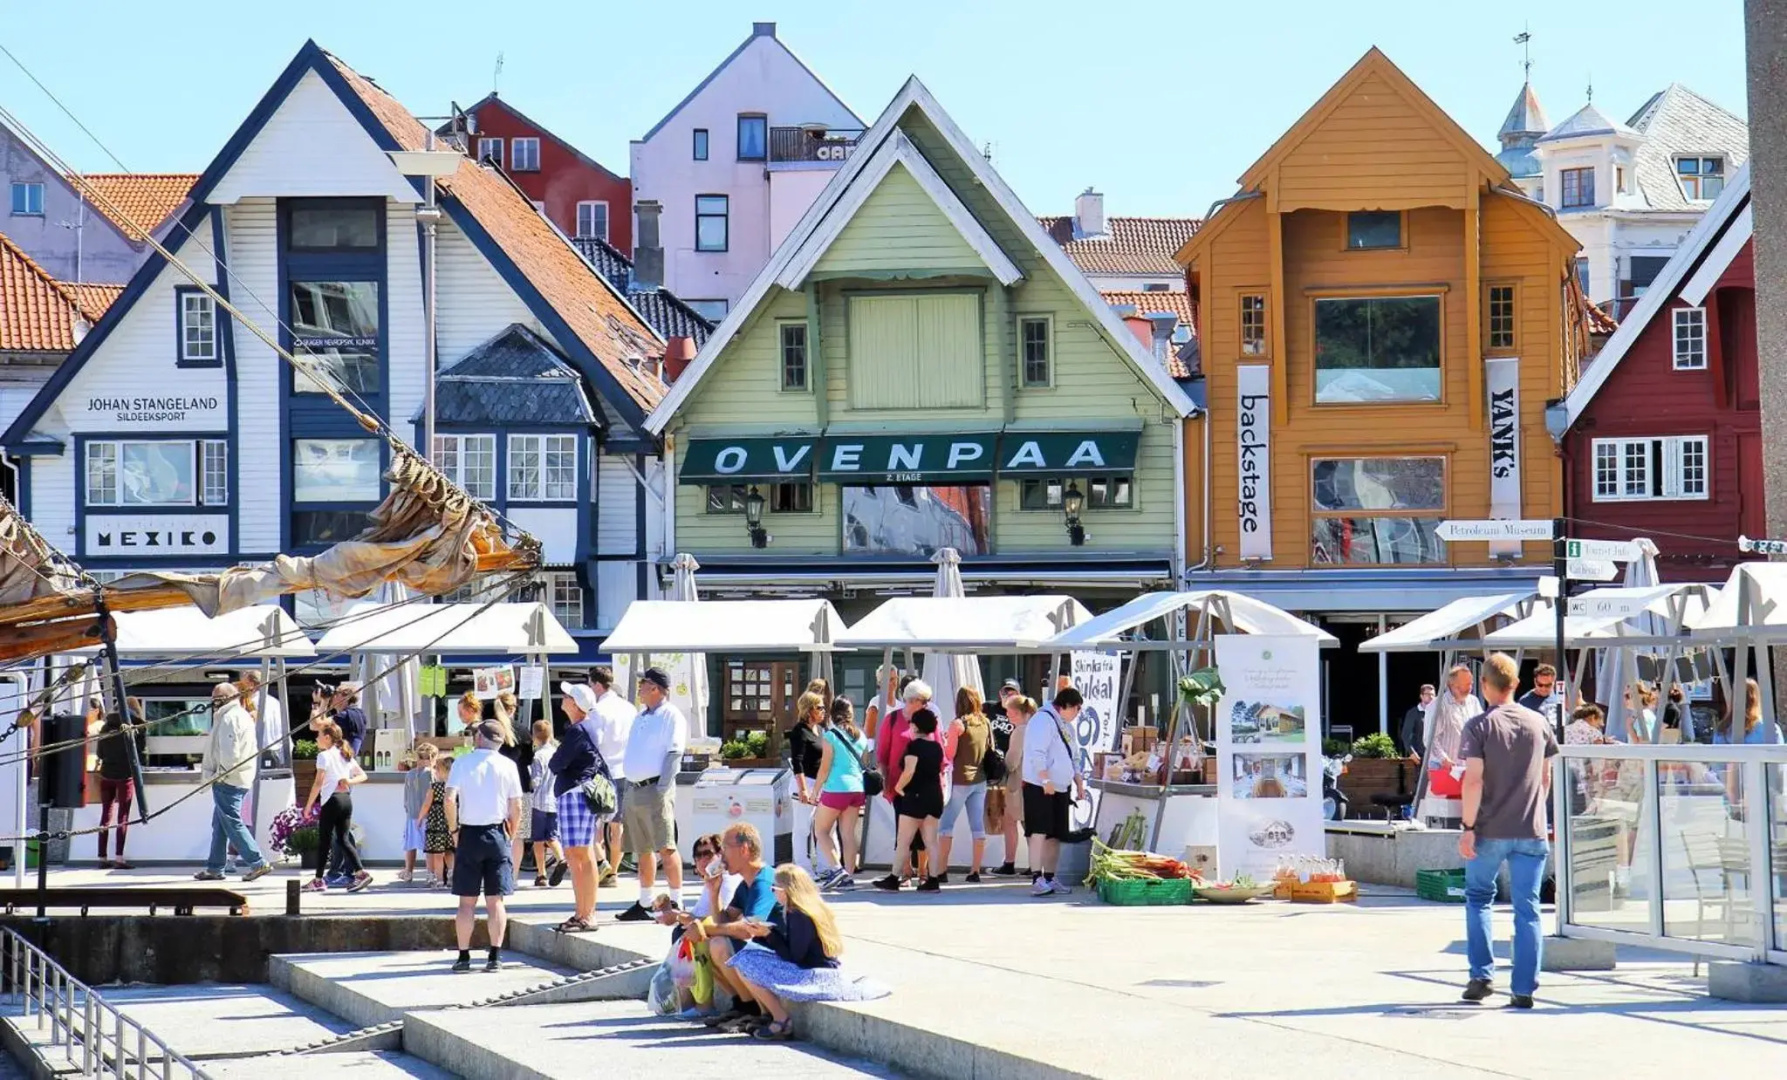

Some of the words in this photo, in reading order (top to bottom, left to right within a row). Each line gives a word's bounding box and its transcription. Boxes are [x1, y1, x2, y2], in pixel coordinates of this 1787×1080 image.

[87, 398, 130, 411] JOHAN
[133, 397, 218, 411] STANGELAND
[116, 412, 186, 422] SILDEEKSPORT
[1491, 388, 1515, 478] YANK's
[713, 440, 1107, 474] OVENPAA
[1239, 394, 1269, 533] backstage
[896, 473, 922, 482] ETAGE
[1450, 524, 1500, 536] Petroleum
[1505, 524, 1547, 536] Museum
[98, 531, 216, 546] MEXIKO
[1572, 603, 1585, 612] WC
[1075, 659, 1102, 673] Skinka
[1074, 675, 1113, 700] Suldal
